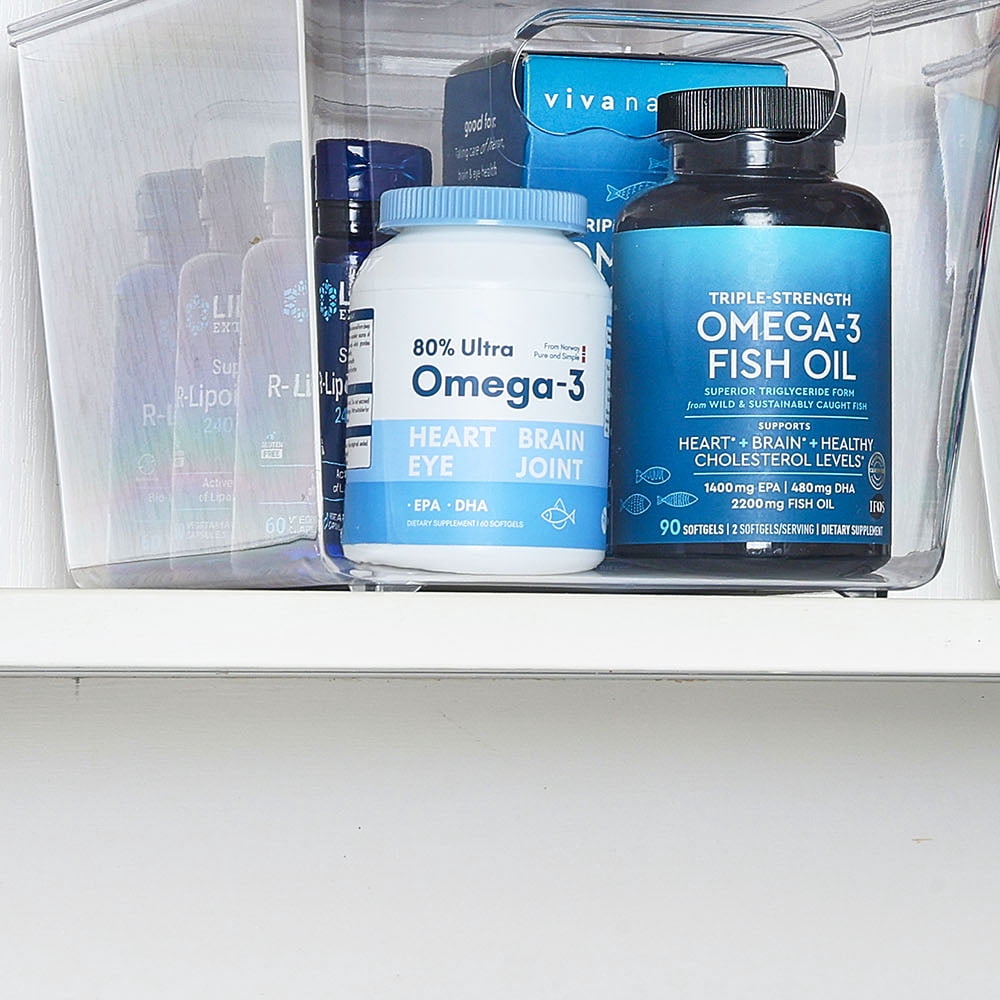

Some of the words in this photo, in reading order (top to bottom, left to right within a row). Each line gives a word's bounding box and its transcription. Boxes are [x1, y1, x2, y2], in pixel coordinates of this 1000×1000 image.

[463, 112, 484, 138] good
[708, 291, 851, 307] TRIPLE-STRENGTH
[696, 310, 862, 344] OMEGA-3
[412, 338, 455, 357] 80%
[461, 337, 514, 357] Ultra
[707, 348, 790, 380] FISH
[802, 348, 857, 381] OIL
[412, 364, 585, 409] Omega-3
[704, 387, 756, 396] SUPERIOR
[758, 386, 830, 397] TRIGLYCERIDE
[832, 388, 855, 397] FORM
[686, 401, 707, 411] from
[709, 400, 736, 409] WILD
[738, 400, 746, 409] &
[748, 400, 814, 409] SUSTAINABLY
[816, 401, 851, 410] CAUGHT
[852, 402, 868, 411] FISH
[758, 421, 811, 431] SUPPORTS
[408, 425, 497, 448] HEART
[518, 427, 585, 452] BRAIN
[821, 436, 874, 451] HEALTHY
[694, 452, 812, 467] CHOLESTEROL
[407, 455, 454, 478] EYE
[515, 456, 584, 481] JOINT
[757, 481, 782, 493] EPA
[834, 483, 856, 495] DHA
[414, 498, 441, 512] EPA
[455, 498, 489, 512] DHA
[788, 498, 814, 510] FISH
[817, 498, 835, 510] OIL
[406, 519, 433, 528] DIETARY
[433, 519, 476, 528] SUPPLEMENT
[659, 518, 681, 536] 90
[682, 523, 724, 536] SOFTGELS
[731, 523, 738, 535] 2
[739, 523, 815, 536] SOFTGELS/SERVING
[821, 524, 851, 536] DIETARY
[850, 524, 884, 537] SUPPLEMENT
